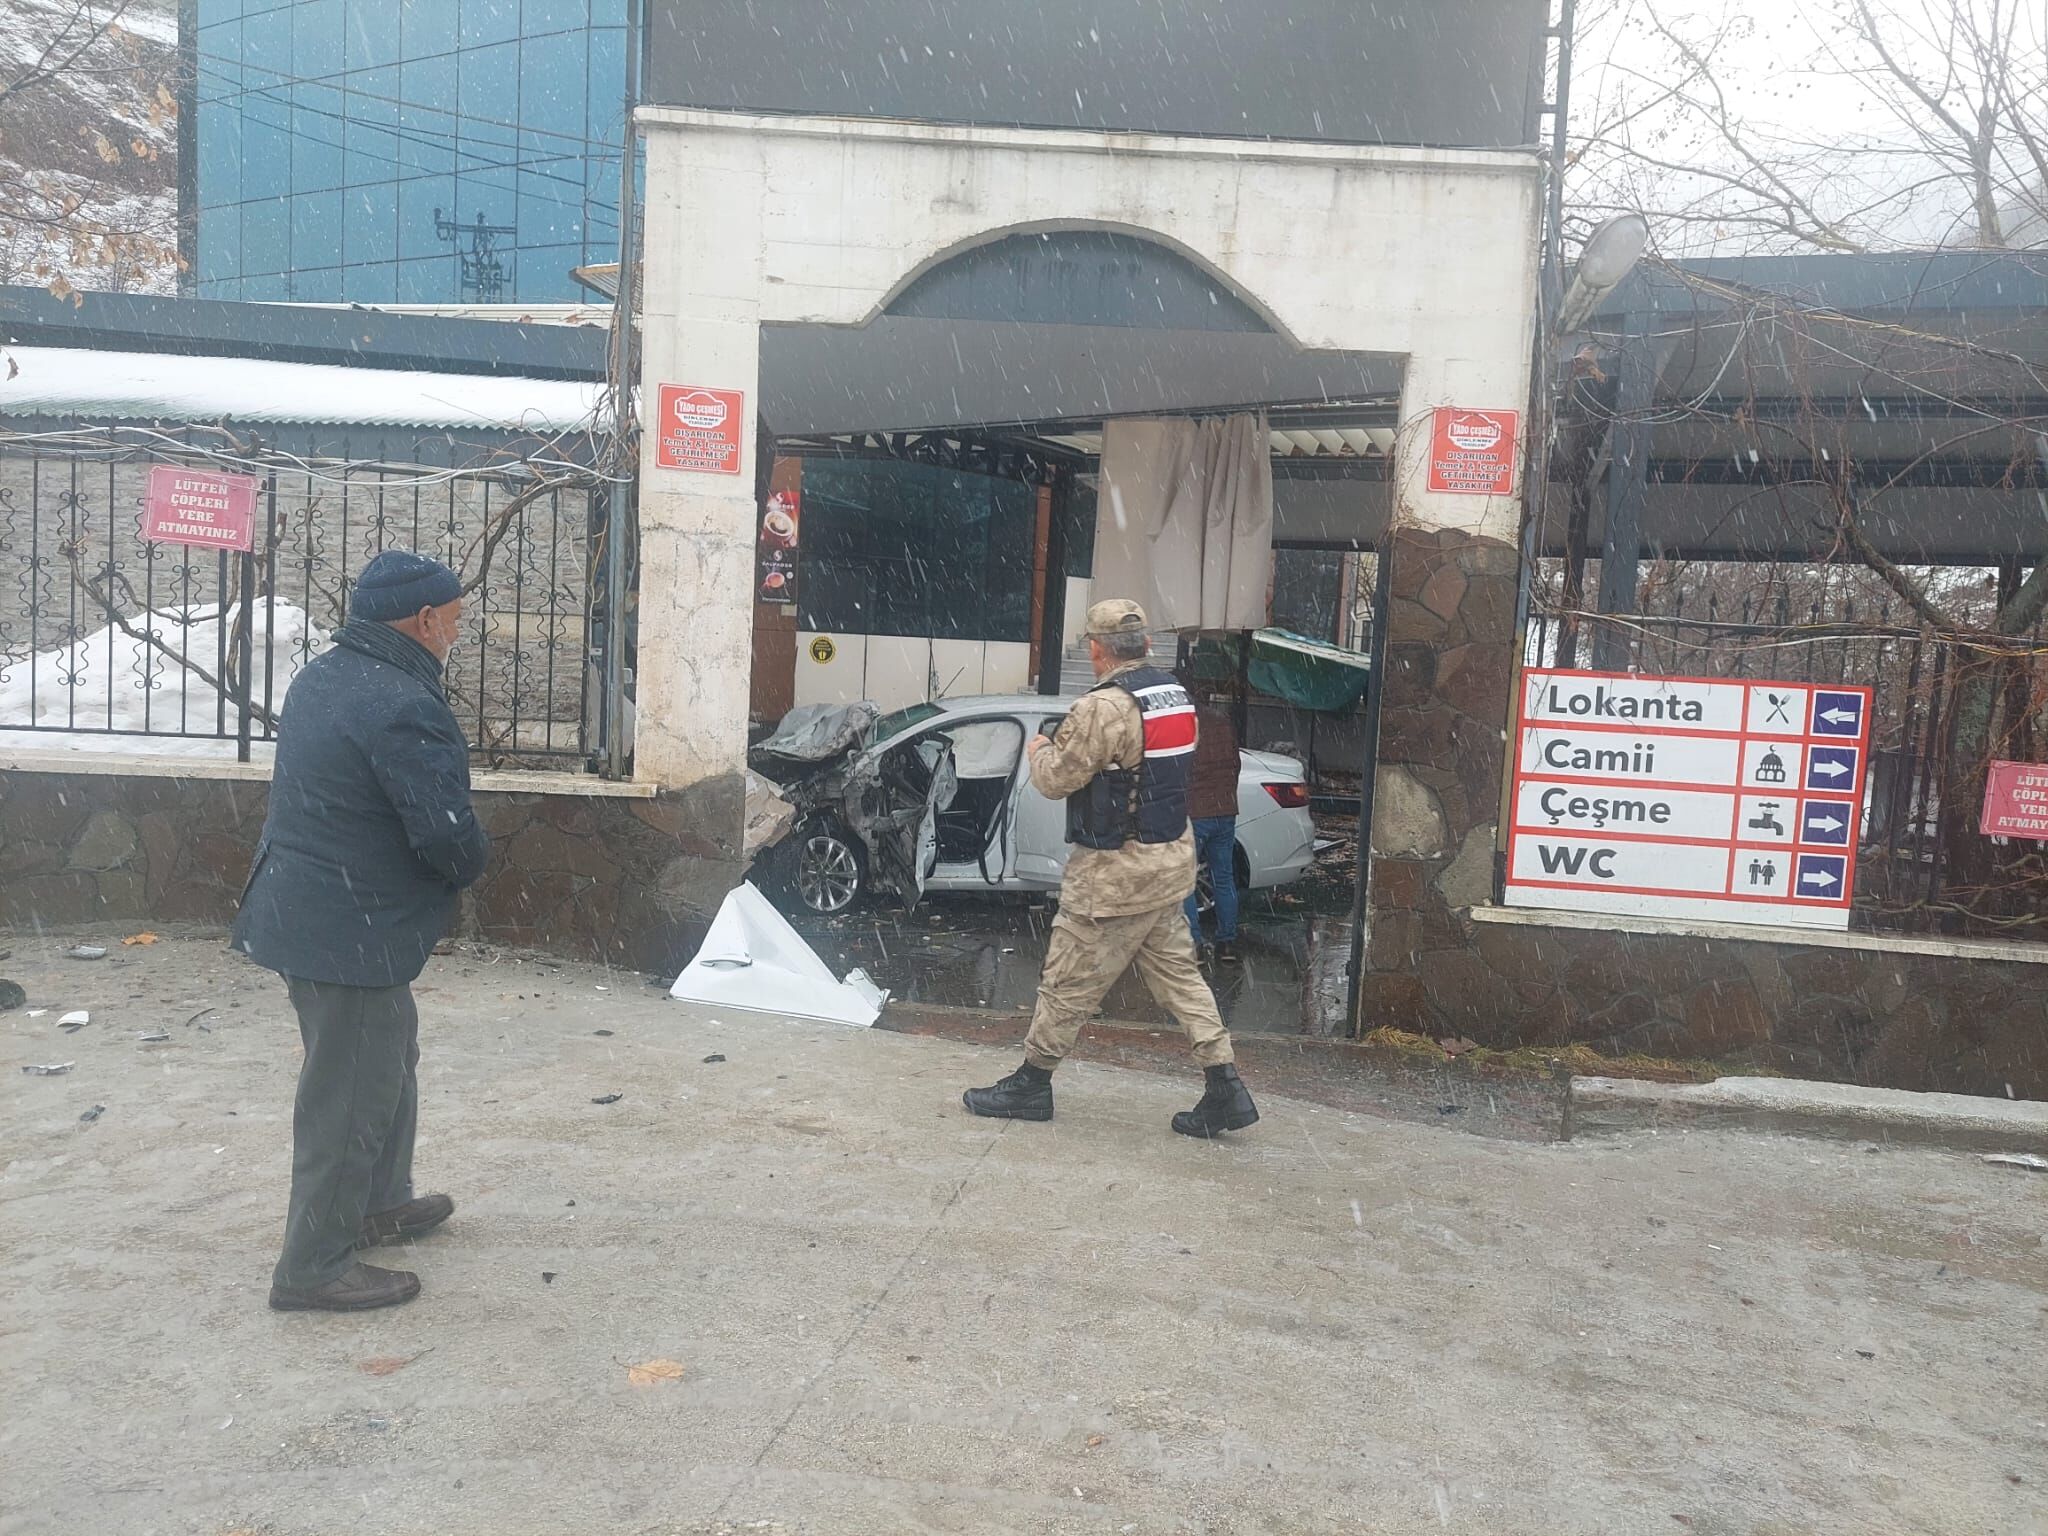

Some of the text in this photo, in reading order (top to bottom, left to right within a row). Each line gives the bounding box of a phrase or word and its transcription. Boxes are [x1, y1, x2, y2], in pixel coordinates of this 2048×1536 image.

[663, 438, 692, 447] Yemek
[695, 440, 702, 448] &
[675, 429, 725, 440] DIŞARIDAN
[676, 459, 721, 469] YASAKTIR
[1435, 461, 1464, 470] Yemek
[1468, 462, 1474, 470] &
[175, 478, 228, 495] LÜTFEN
[1447, 481, 1493, 490] YASAKTIR
[170, 492, 230, 510] ÇÖPLERİ
[178, 509, 215, 523] YERE
[157, 521, 238, 540] ATMAYINIZ
[1548, 684, 1703, 722] Lokanta
[1543, 738, 1655, 774] Camii
[1539, 787, 1672, 828] Çeşme
[1537, 844, 1618, 879] WC
